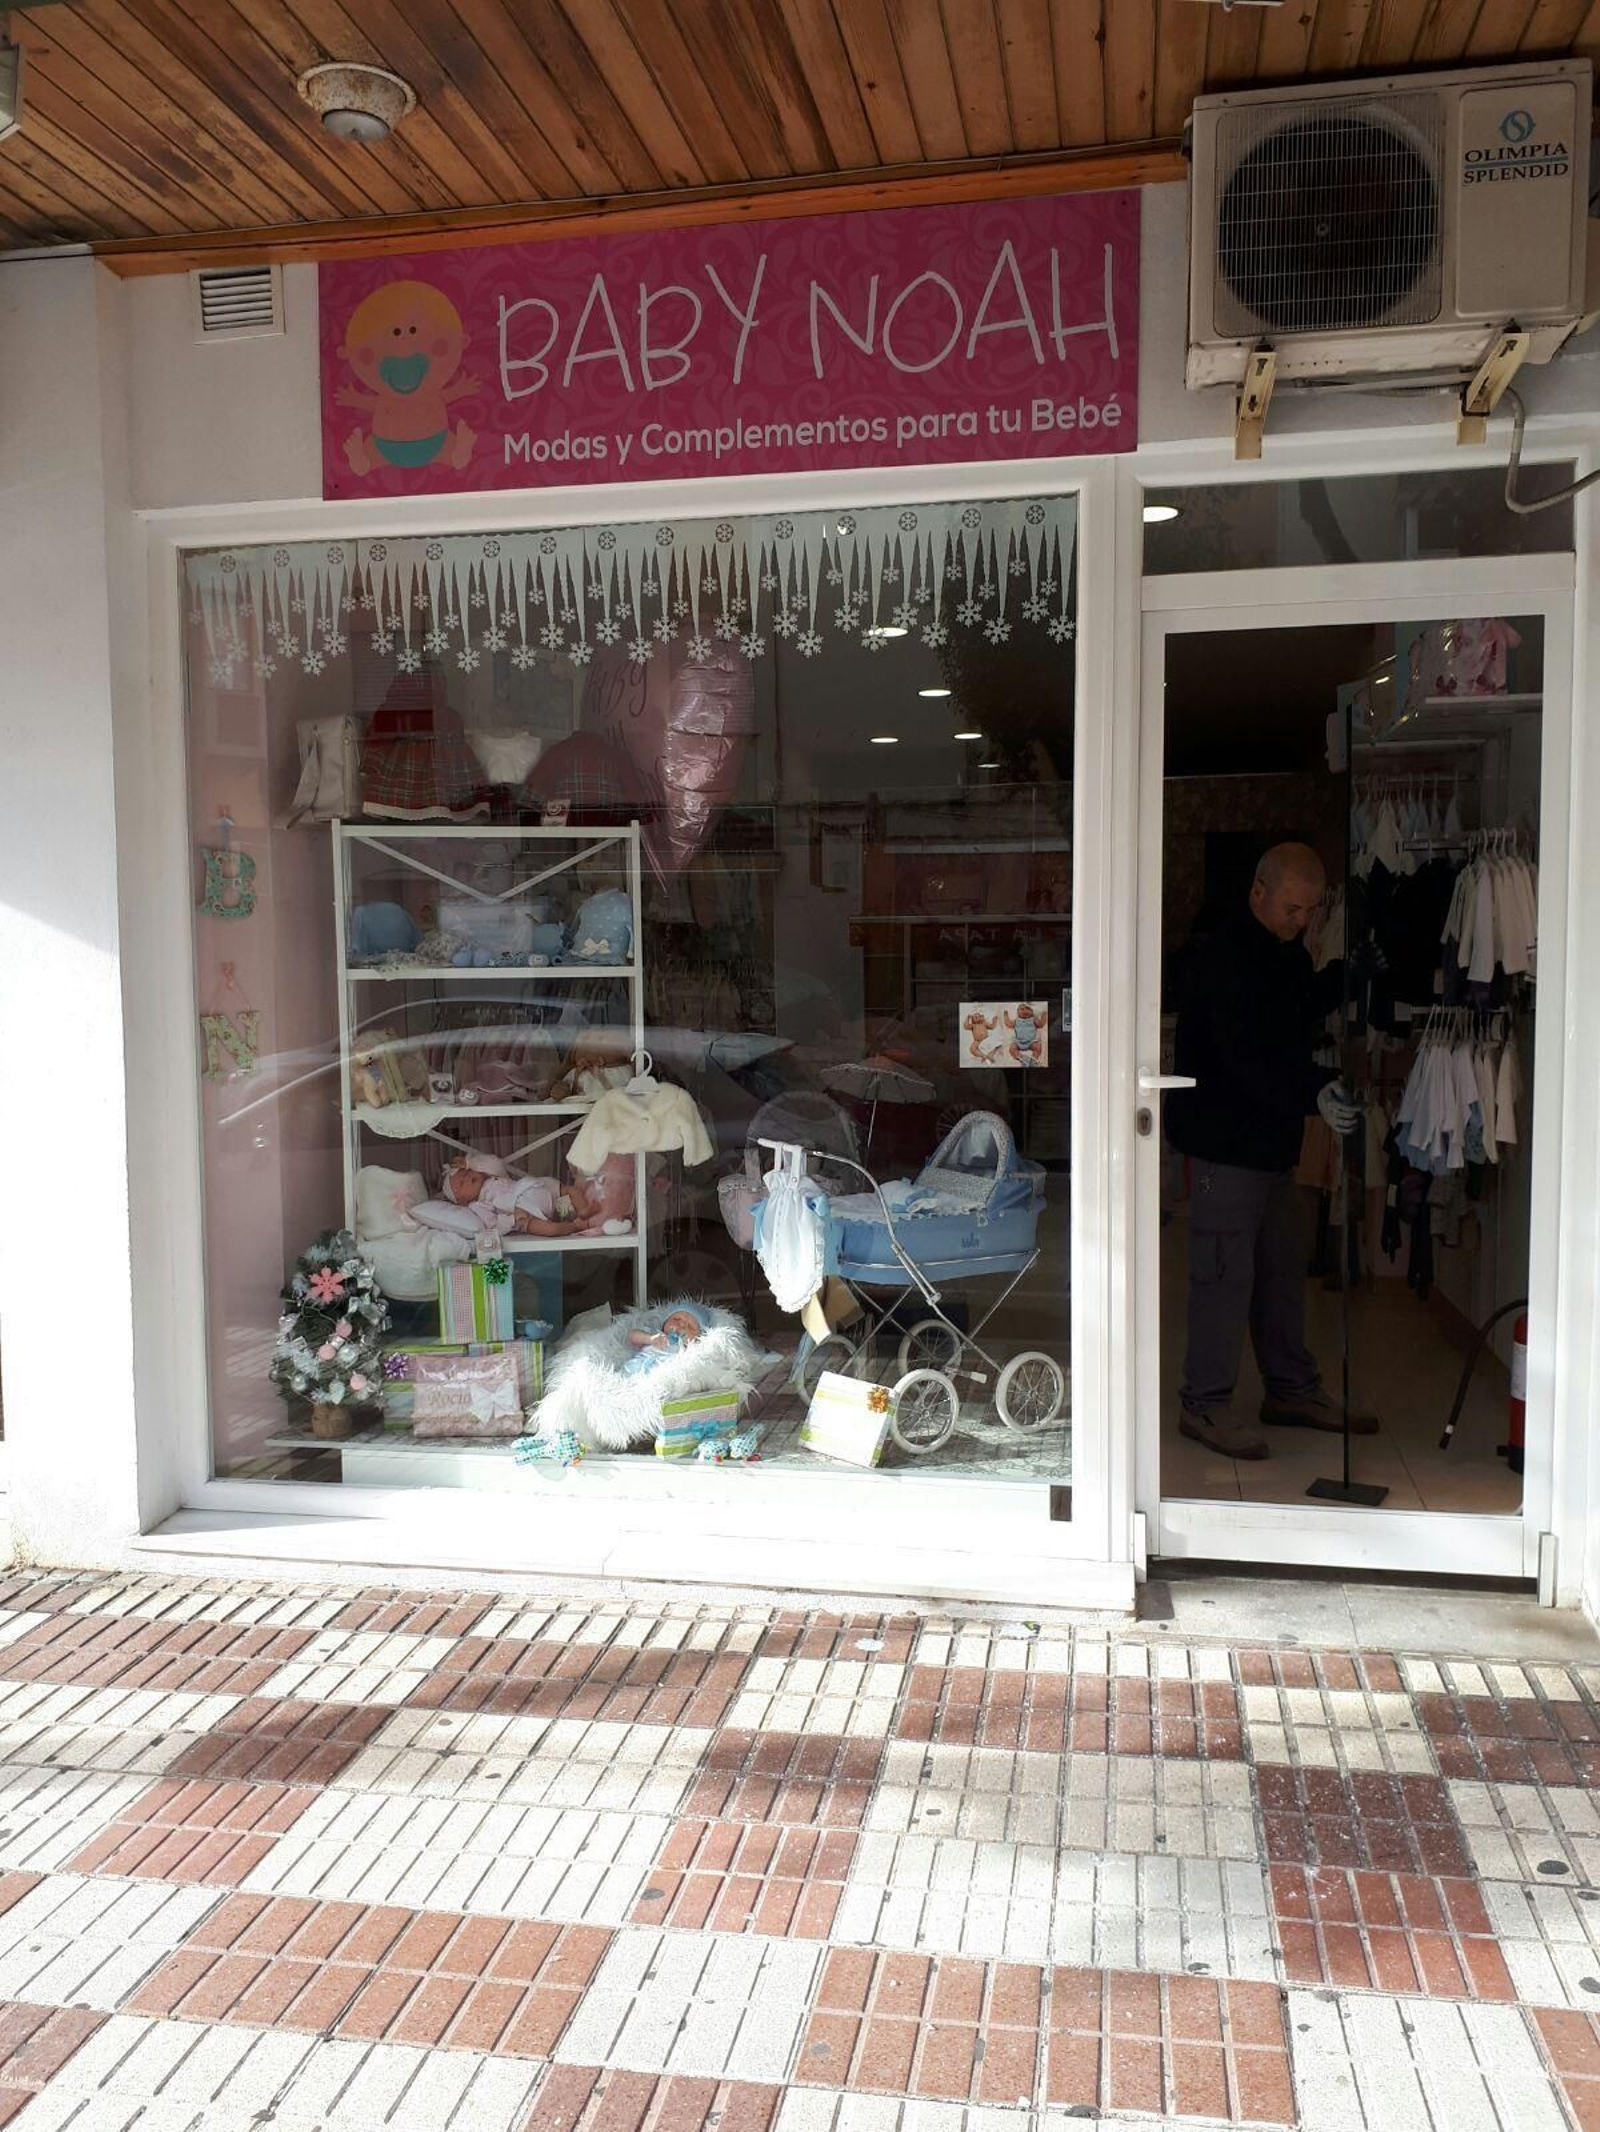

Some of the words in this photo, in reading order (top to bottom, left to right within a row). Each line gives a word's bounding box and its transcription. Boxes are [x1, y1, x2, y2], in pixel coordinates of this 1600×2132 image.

[1463, 163, 1569, 184] SPLENDID
[1464, 142, 1568, 163] OLIMPIA
[497, 254, 767, 401] BABY
[810, 240, 1119, 378] NOAH
[504, 430, 608, 465] Modas
[616, 434, 633, 465] y
[642, 416, 889, 459] Complementos
[896, 413, 979, 449] para
[987, 404, 1022, 435] tu
[1031, 393, 1122, 431] Bebé
